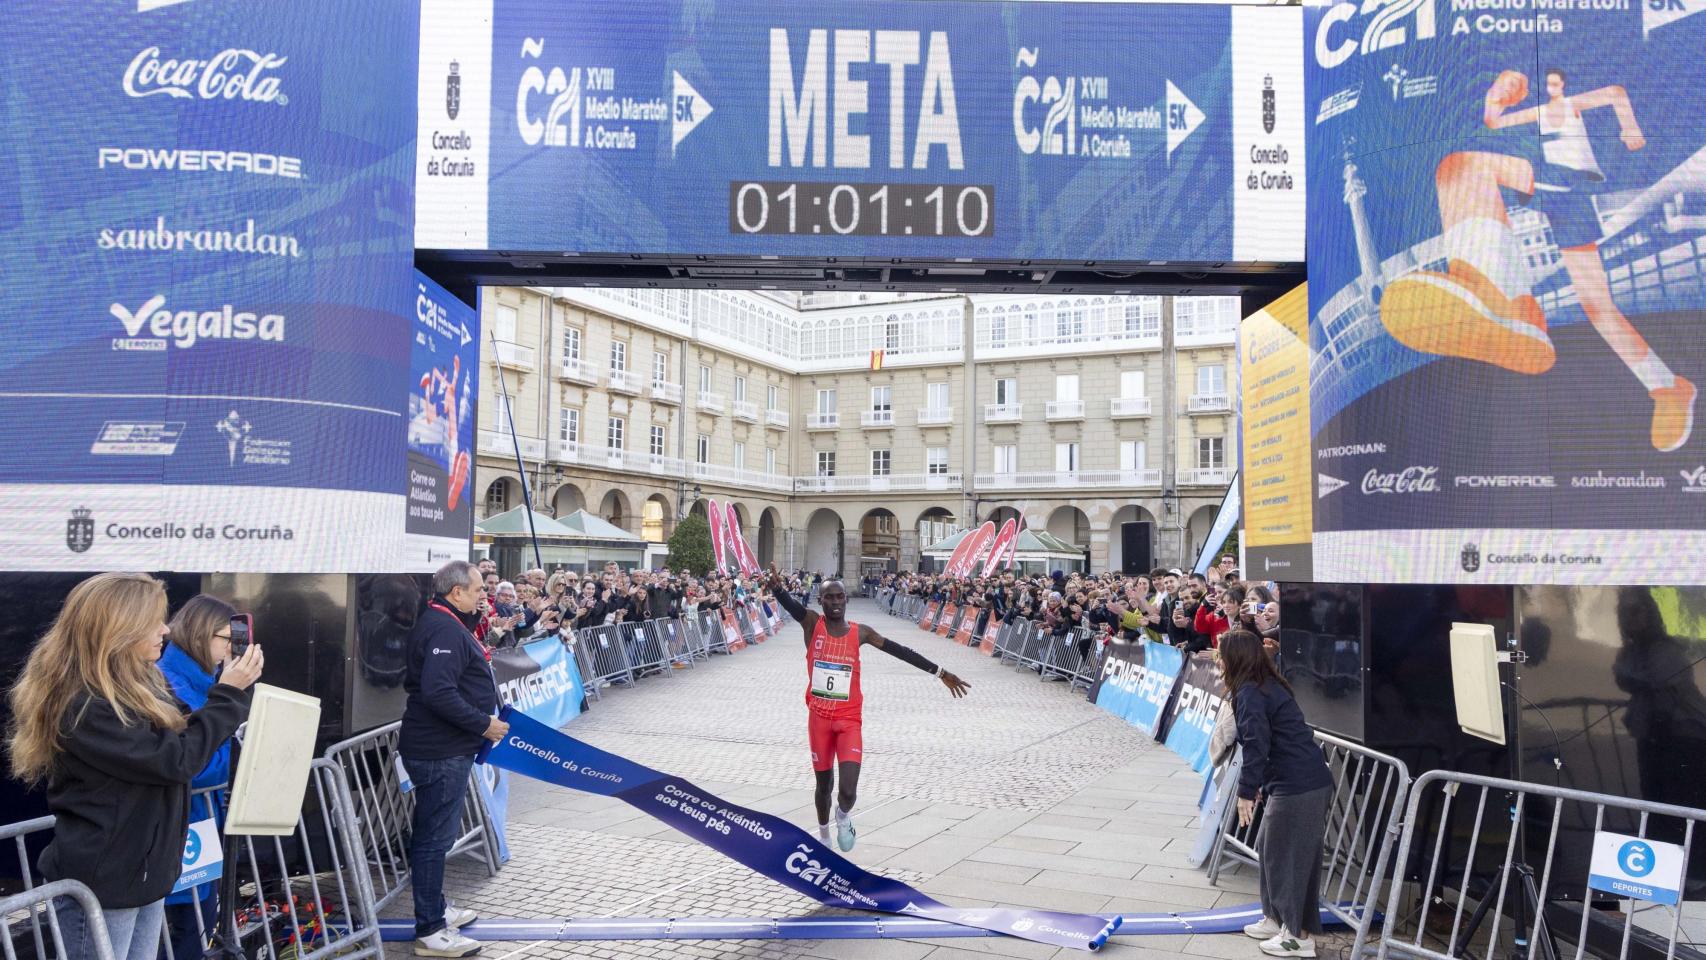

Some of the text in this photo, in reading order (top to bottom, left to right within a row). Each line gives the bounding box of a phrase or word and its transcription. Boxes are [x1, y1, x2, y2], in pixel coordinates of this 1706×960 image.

[1451, 13, 1564, 36] A Coruña
[122, 46, 288, 102] Coca-Cola
[585, 66, 615, 91] XVIII
[767, 27, 965, 170] META
[1081, 76, 1108, 99] XVIII
[584, 96, 668, 122] Medio Maratón
[674, 94, 695, 122] 5K
[1081, 105, 1161, 129] Medio Maratón
[1168, 103, 1188, 130] 5K
[432, 130, 472, 150] Concello
[584, 124, 636, 150] A Coruña
[1081, 134, 1131, 157] A Coruña
[98, 147, 301, 178] POWERADE
[1250, 144, 1289, 165] Concello
[428, 156, 475, 178] da Coruña
[1246, 170, 1294, 191] da Coruña
[736, 183, 989, 236] 01:01:10
[97, 216, 301, 257] sanbrandan
[109, 294, 286, 348] Vegalsa
[1318, 443, 1387, 459] PATROCINAN:
[411, 470, 427, 485] Corre
[1361, 466, 1438, 494] Coca-Cola
[1455, 475, 1554, 488] POWERADE
[1571, 470, 1665, 488] sanbrandan
[410, 486, 437, 503] Atlántico
[106, 523, 294, 541] Concello da Coruña
[1486, 551, 1602, 565] Concello da Coruña
[826, 675, 835, 691] 6
[1100, 655, 1175, 707] POWERADE
[1173, 682, 1222, 735] POWE
[508, 735, 623, 783] Concello da Coruña
[655, 792, 732, 836] aos teus pés
[663, 784, 773, 841] Corre co Atlántico
[180, 870, 208, 884] DEPORTES
[831, 873, 851, 886] XVIII
[826, 879, 879, 907] Medio Maratón
[829, 887, 856, 905] Coruña
[1612, 881, 1653, 897] DEPORTES
[1038, 924, 1091, 941] Concello
